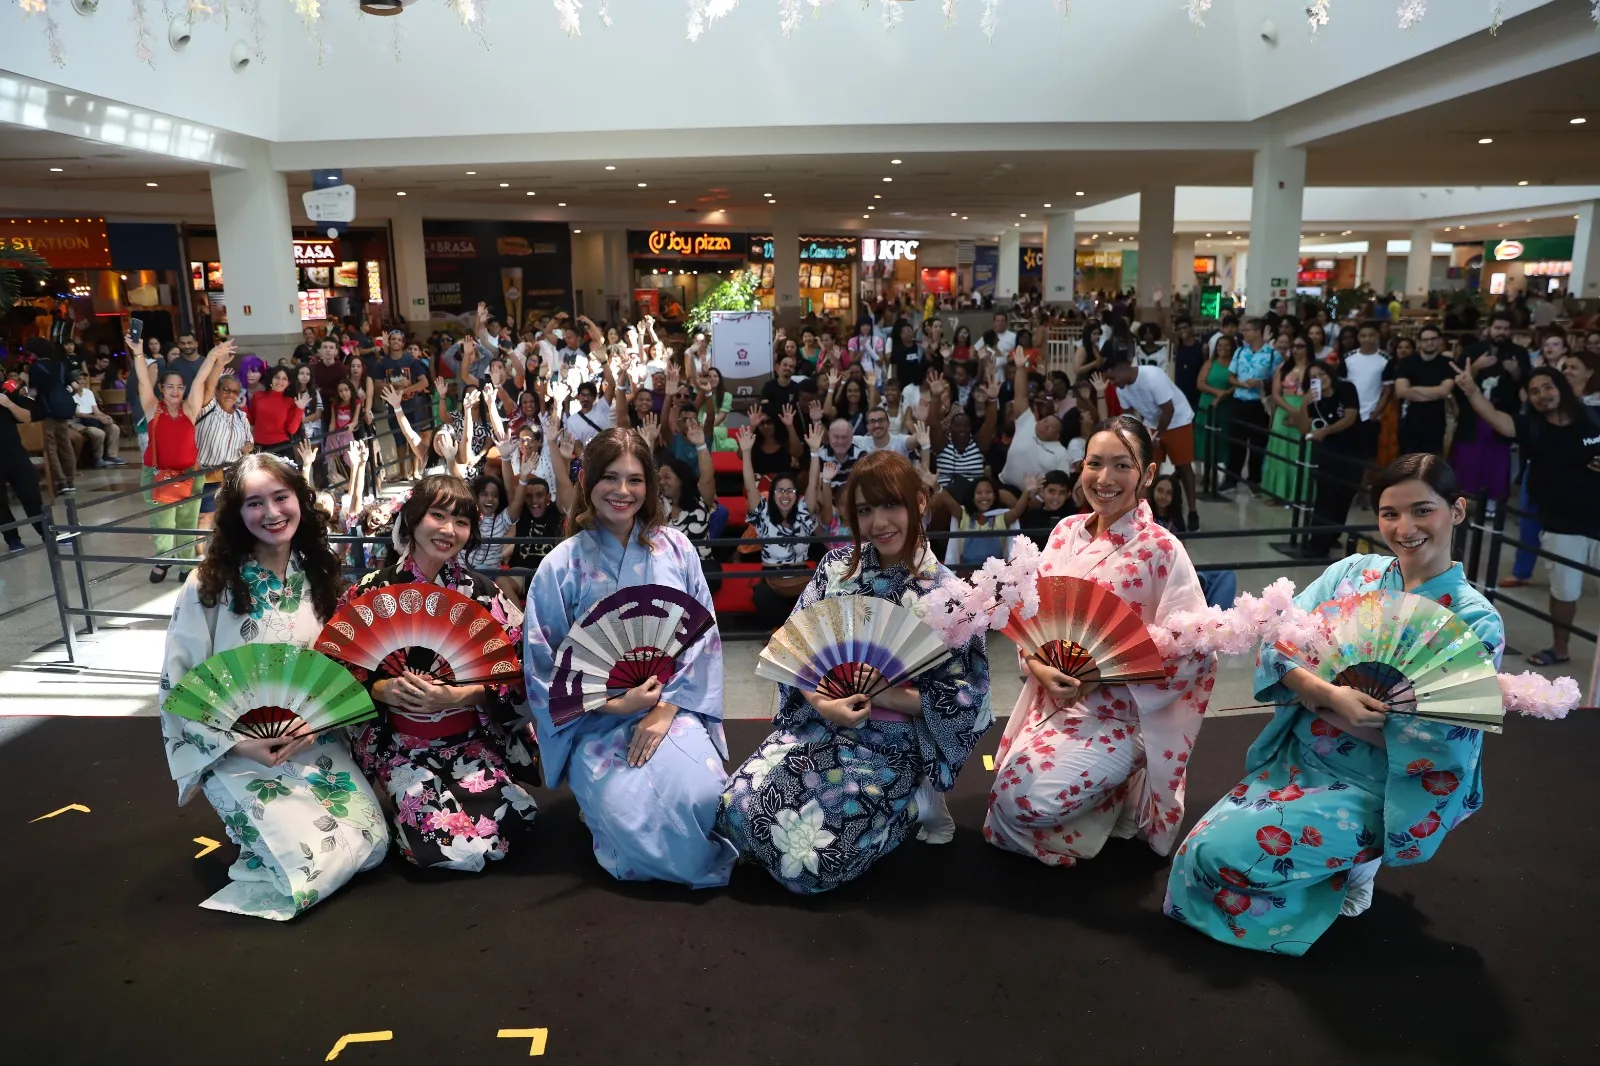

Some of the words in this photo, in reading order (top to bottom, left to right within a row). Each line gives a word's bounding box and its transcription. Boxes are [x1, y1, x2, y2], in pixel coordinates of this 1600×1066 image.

[11, 237, 90, 250] STATION
[437, 240, 475, 253] BRASA
[695, 233, 731, 254] pizza
[879, 240, 920, 260] KFC
[293, 245, 335, 258] RASA
